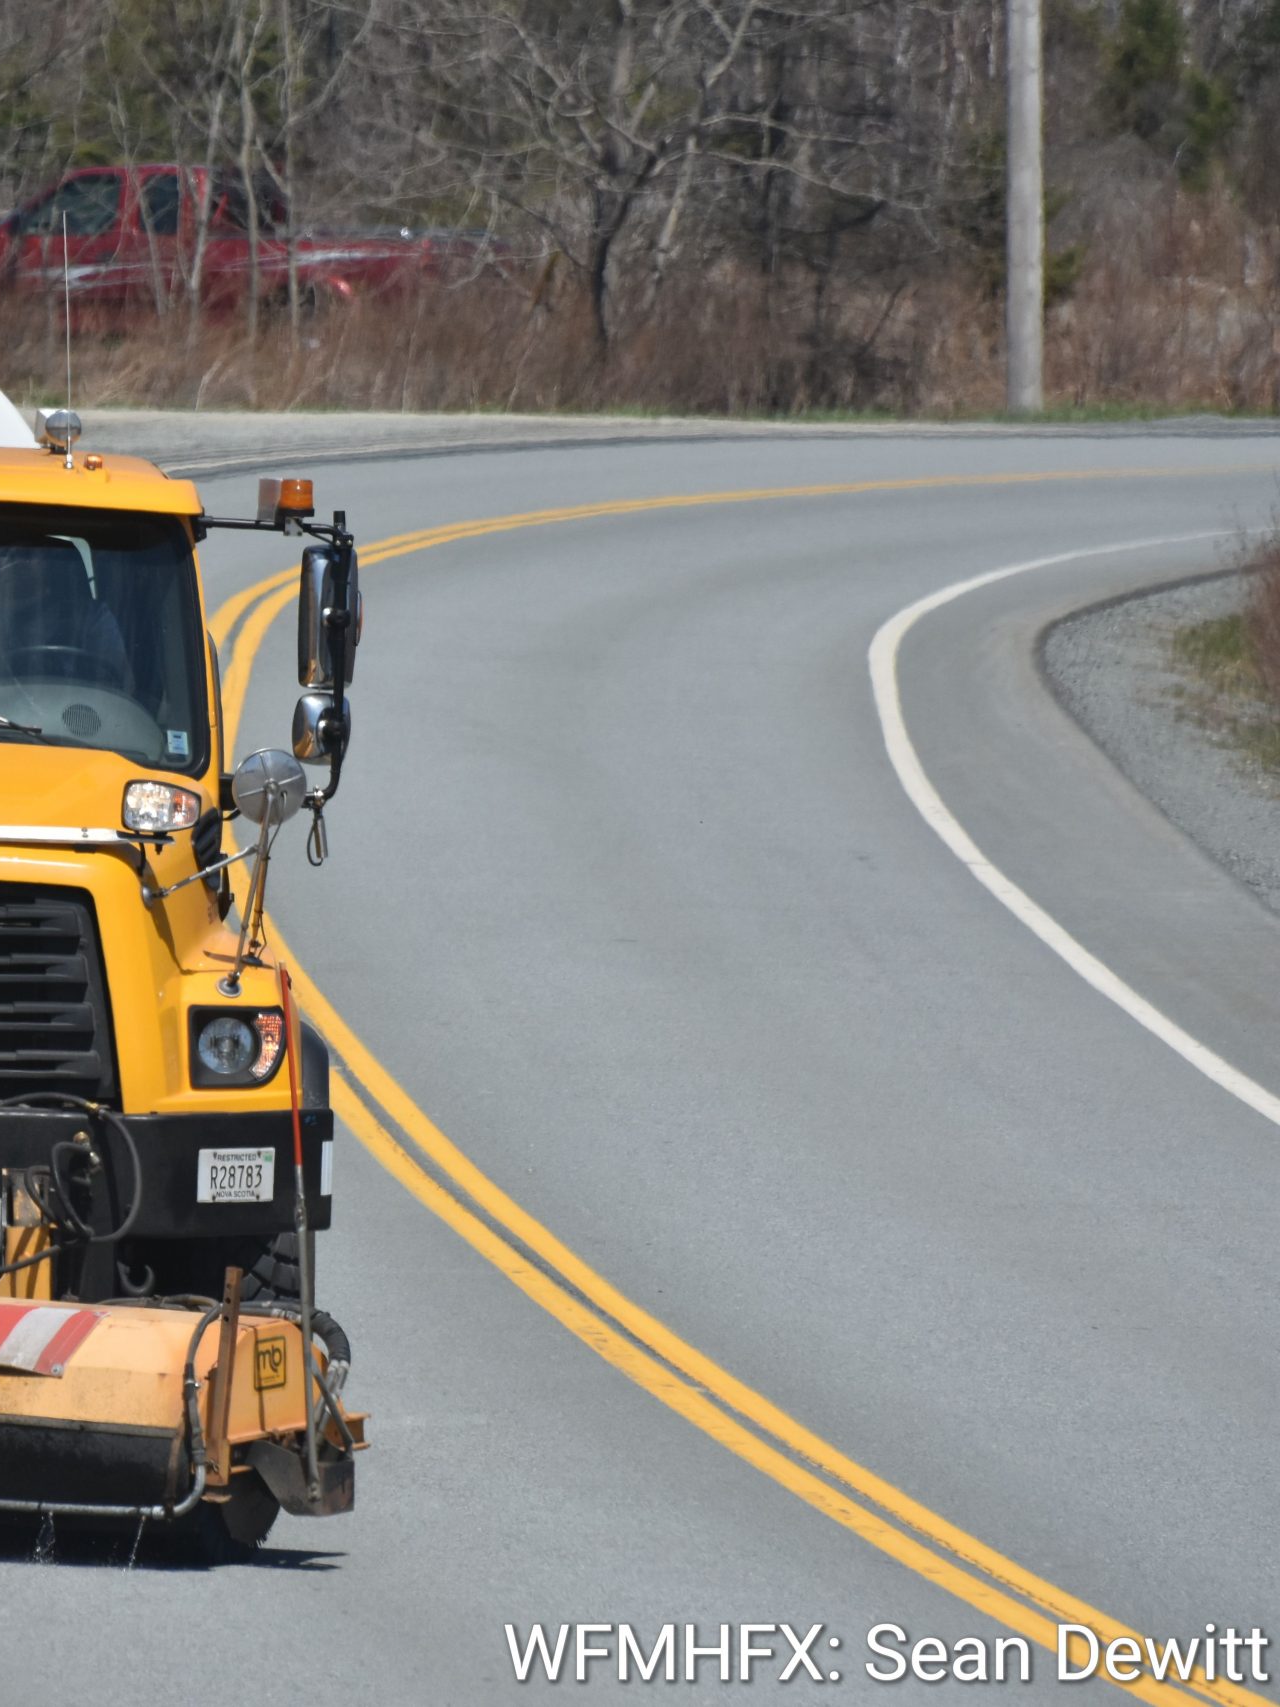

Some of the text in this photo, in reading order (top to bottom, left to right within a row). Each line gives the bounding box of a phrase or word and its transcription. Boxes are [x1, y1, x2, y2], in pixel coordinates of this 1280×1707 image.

[217, 1153, 257, 1162] RESTRICTED
[210, 1164, 263, 1190] R28783
[216, 1190, 256, 1198] NOVA SCOTIA
